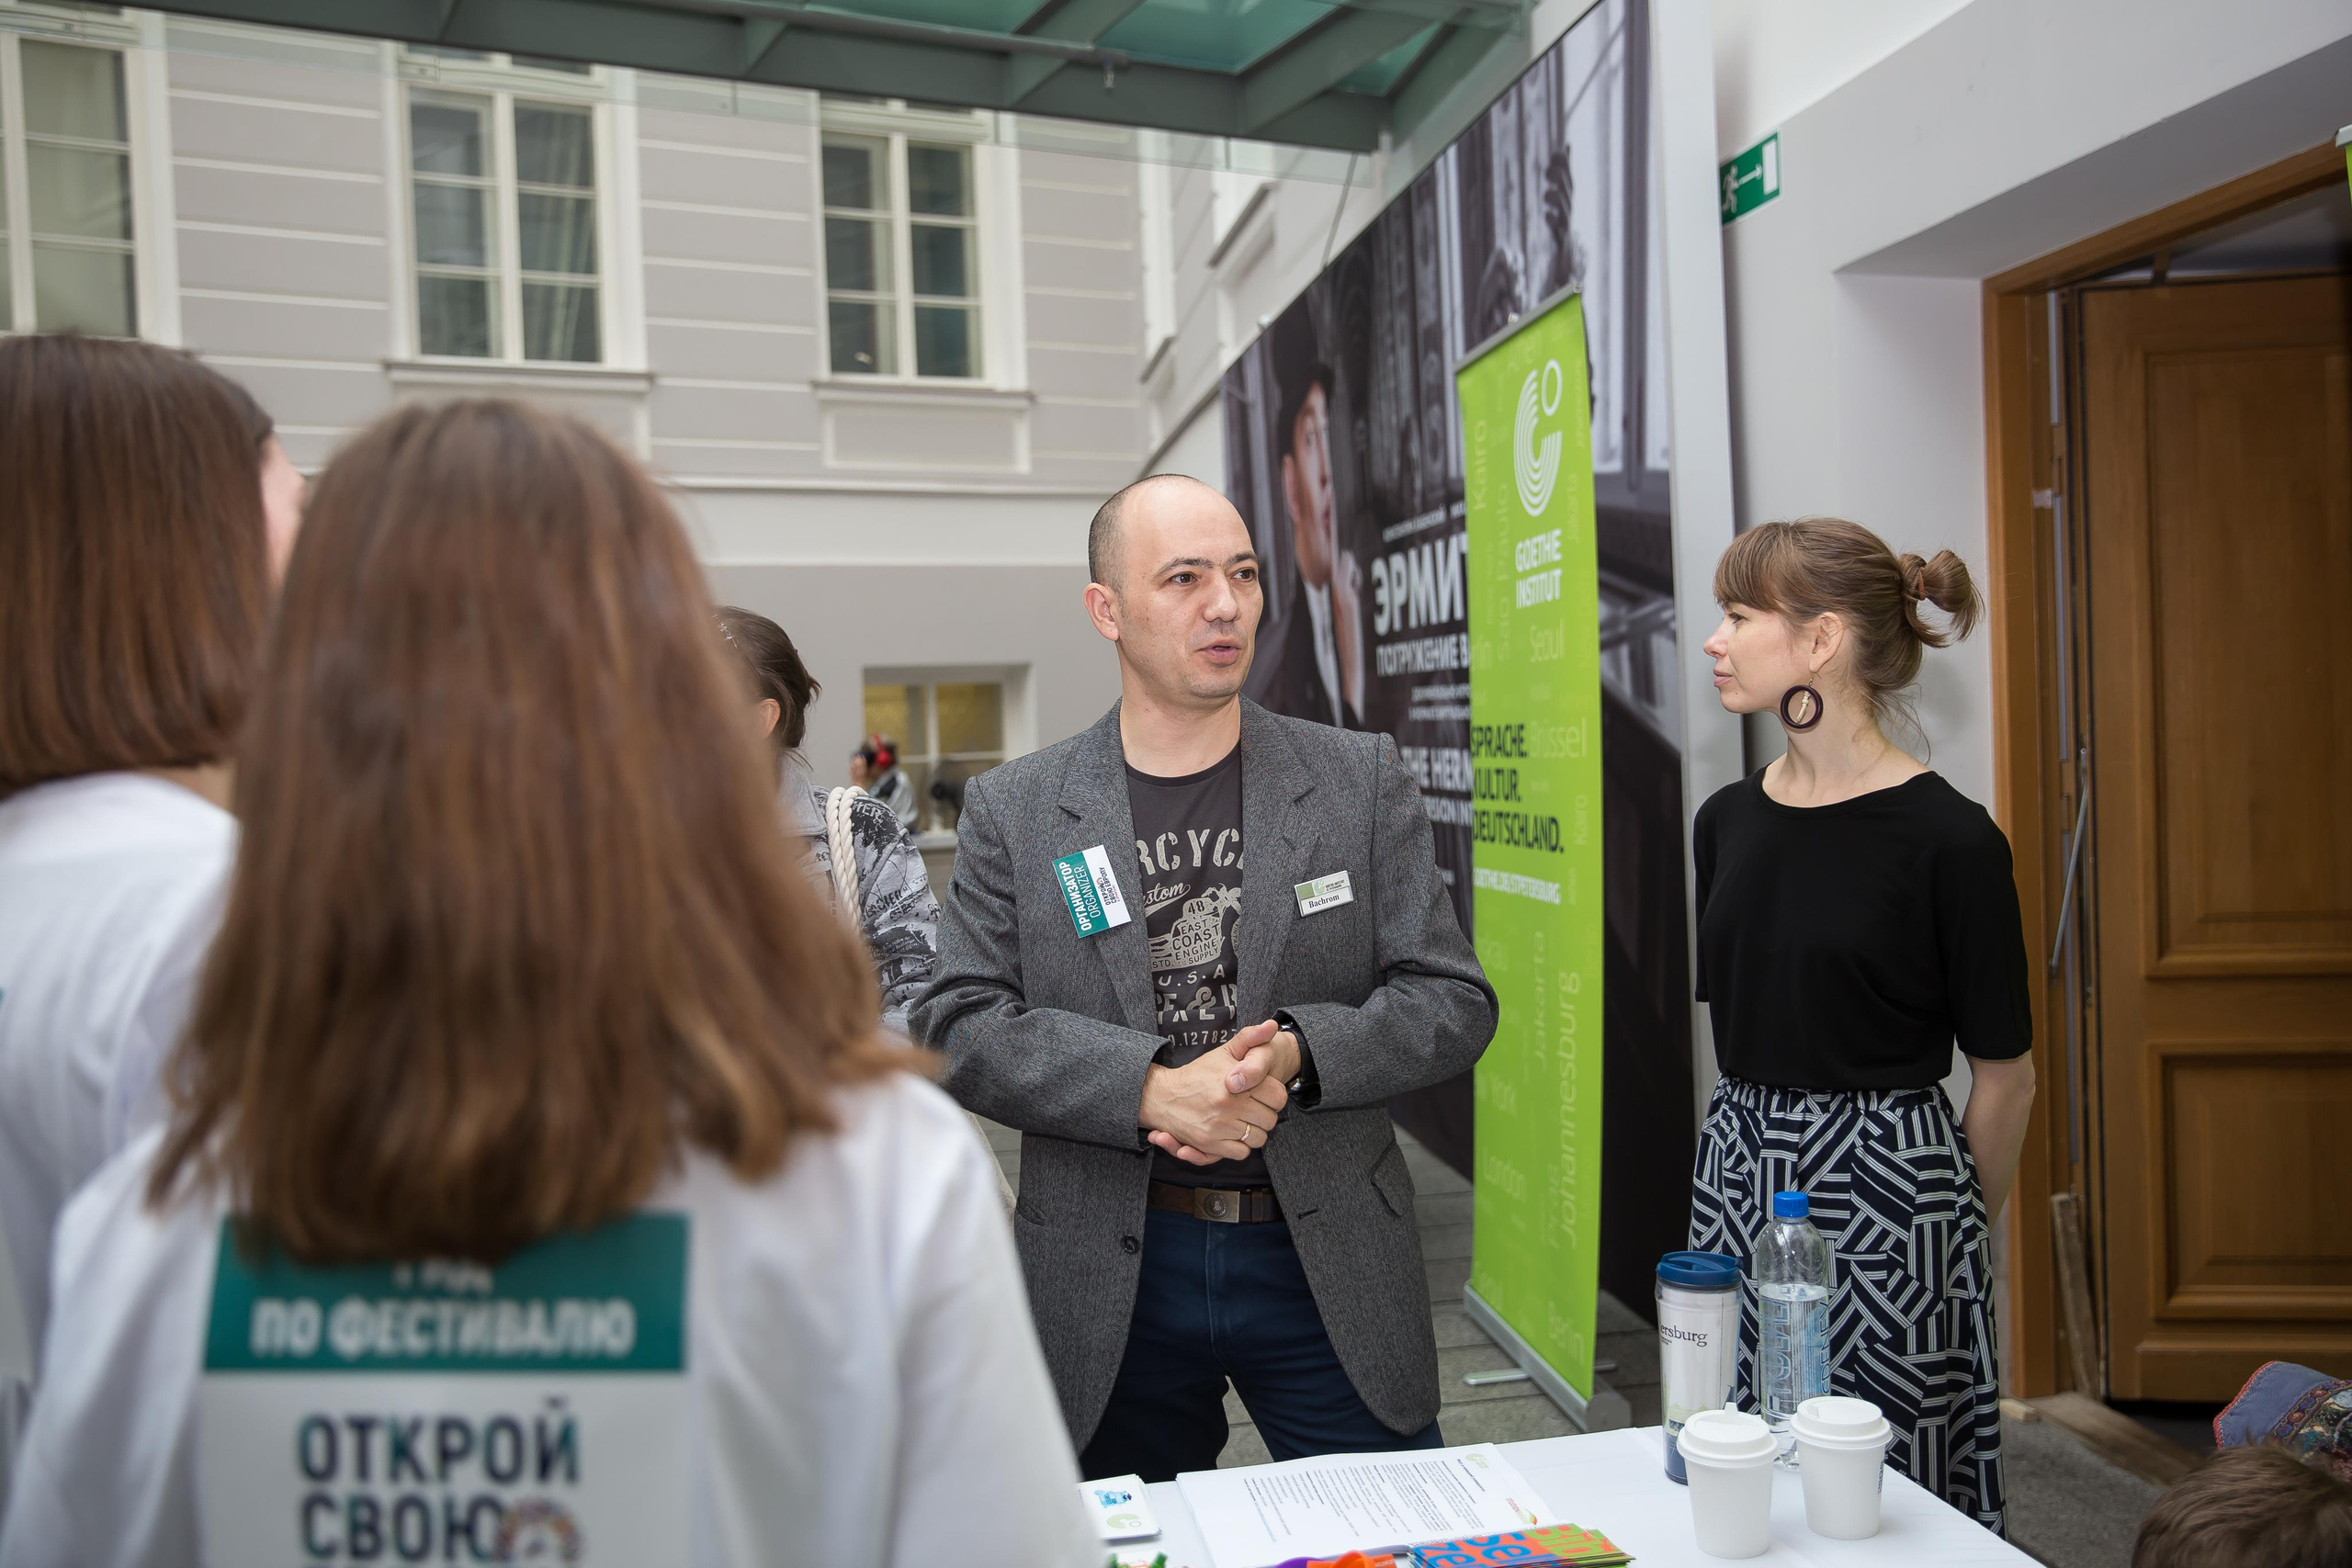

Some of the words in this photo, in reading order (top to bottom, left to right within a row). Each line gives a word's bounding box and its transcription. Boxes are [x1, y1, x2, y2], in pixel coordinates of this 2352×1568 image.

[1474, 419, 1488, 511] Kairo
[1497, 481, 1510, 581] Paulo
[1515, 528, 1562, 573] GOETHE
[1515, 569, 1562, 609] INSTITUT
[1530, 616, 1565, 663] Seoul
[1471, 724, 1527, 759] SPRACHE.
[1472, 768, 1521, 803] KULTUR.
[1136, 828, 1243, 875] RCYC
[1472, 810, 1565, 854] DEUTSCHLAND.
[1058, 862, 1092, 932] ОРГАНИЗАТОР
[1073, 864, 1102, 919] ORGANIZER
[1188, 900, 1205, 915] 48
[1307, 894, 1340, 908] Bachrom
[1172, 923, 1220, 951] COAST
[1175, 938, 1217, 961] ENGINE
[1181, 919, 1208, 935] EAST
[1188, 946, 1219, 964] SUPPLY
[1532, 931, 1547, 1072] Jakarta
[1558, 970, 1582, 1248] Johannesburg
[1483, 1146, 1527, 1202] London
[248, 1296, 324, 1356] ПО
[326, 1294, 639, 1358] ФЕСТИВАЛЮ
[1660, 1325, 1708, 1348] ersburg
[297, 1395, 582, 1485] ОТКРОЙ
[300, 1493, 504, 1563] СВОЮ
